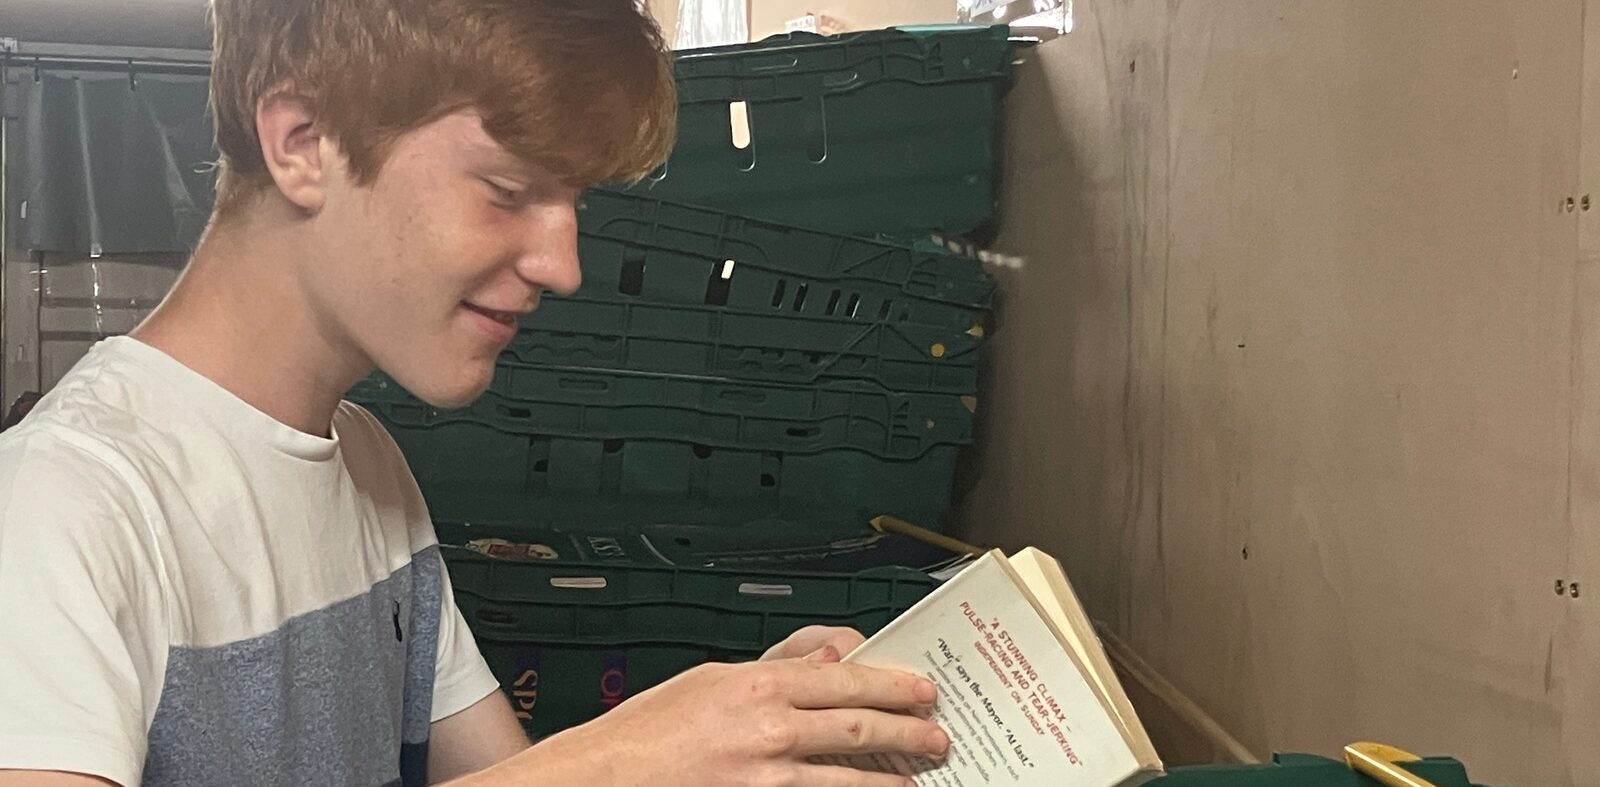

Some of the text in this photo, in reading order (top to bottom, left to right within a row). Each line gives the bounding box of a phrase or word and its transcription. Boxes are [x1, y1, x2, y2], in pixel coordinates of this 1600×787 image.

[960, 601, 1014, 668] PULSE-RACING
[1011, 670, 1030, 690] AND
[974, 641, 1045, 735] INDEPENDENT ON SUNDAY
[998, 630, 1038, 681] STUNNING
[1037, 683, 1066, 722] CLIMAX
[956, 665, 971, 683] says
[969, 682, 983, 697] the
[981, 698, 1003, 728] Mayor.
[1006, 729, 1017, 745] “At
